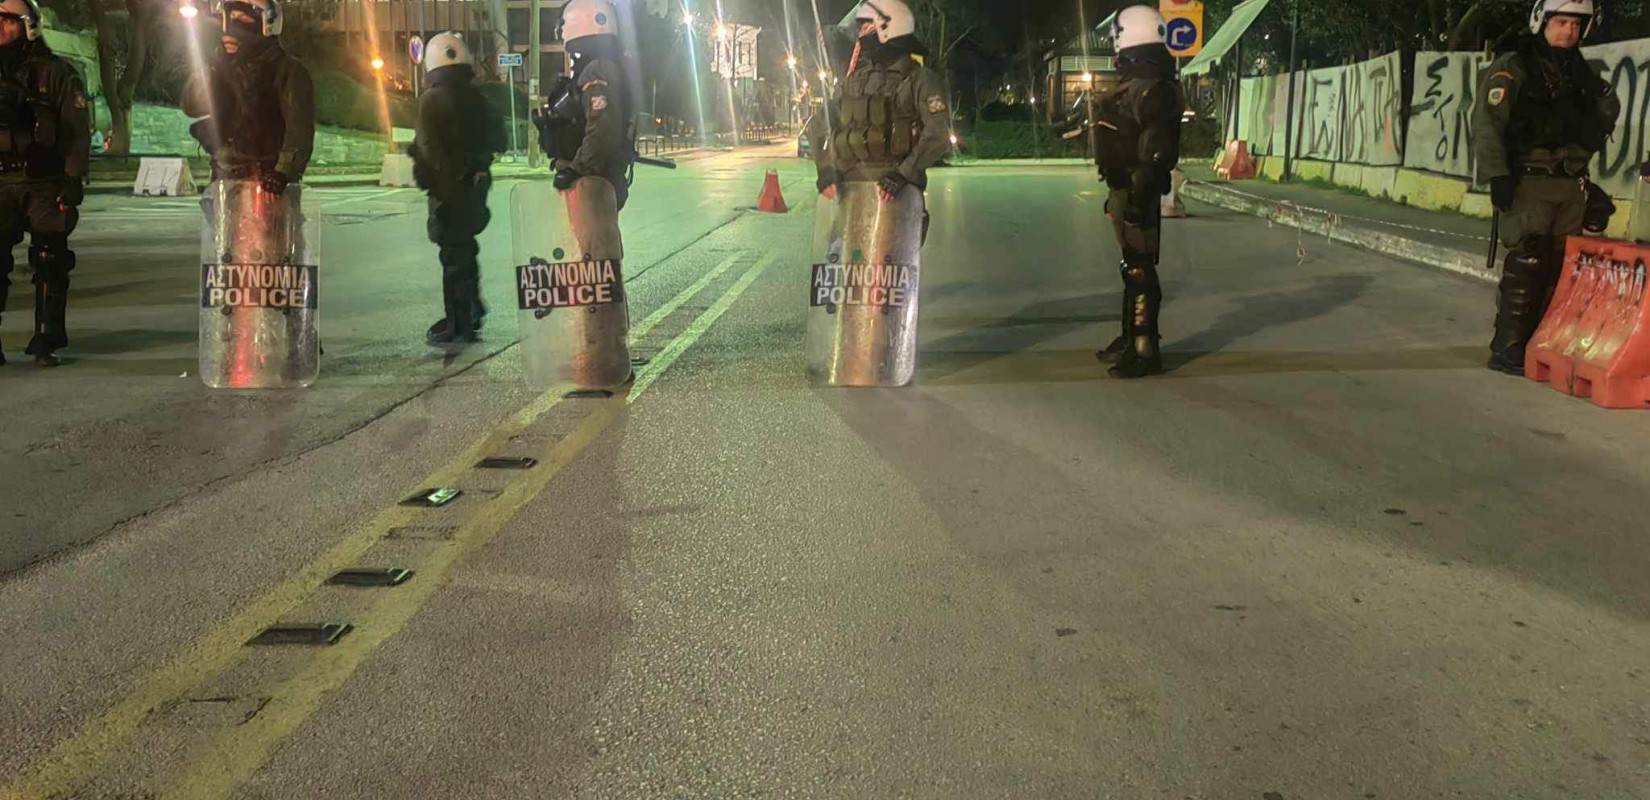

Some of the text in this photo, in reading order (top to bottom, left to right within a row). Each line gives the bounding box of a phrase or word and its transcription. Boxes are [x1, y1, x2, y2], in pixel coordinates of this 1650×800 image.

[206, 265, 311, 288] ΑΣΤΥΝΟΜΙΑ
[521, 260, 616, 289] ΑΣΤΥΝΟΜΙΑ
[815, 264, 910, 288] ΑΣΤΥΝΟΜΙΑ
[210, 287, 305, 307] POLICE
[525, 283, 612, 308] POLICE
[817, 286, 905, 306] POLICE
